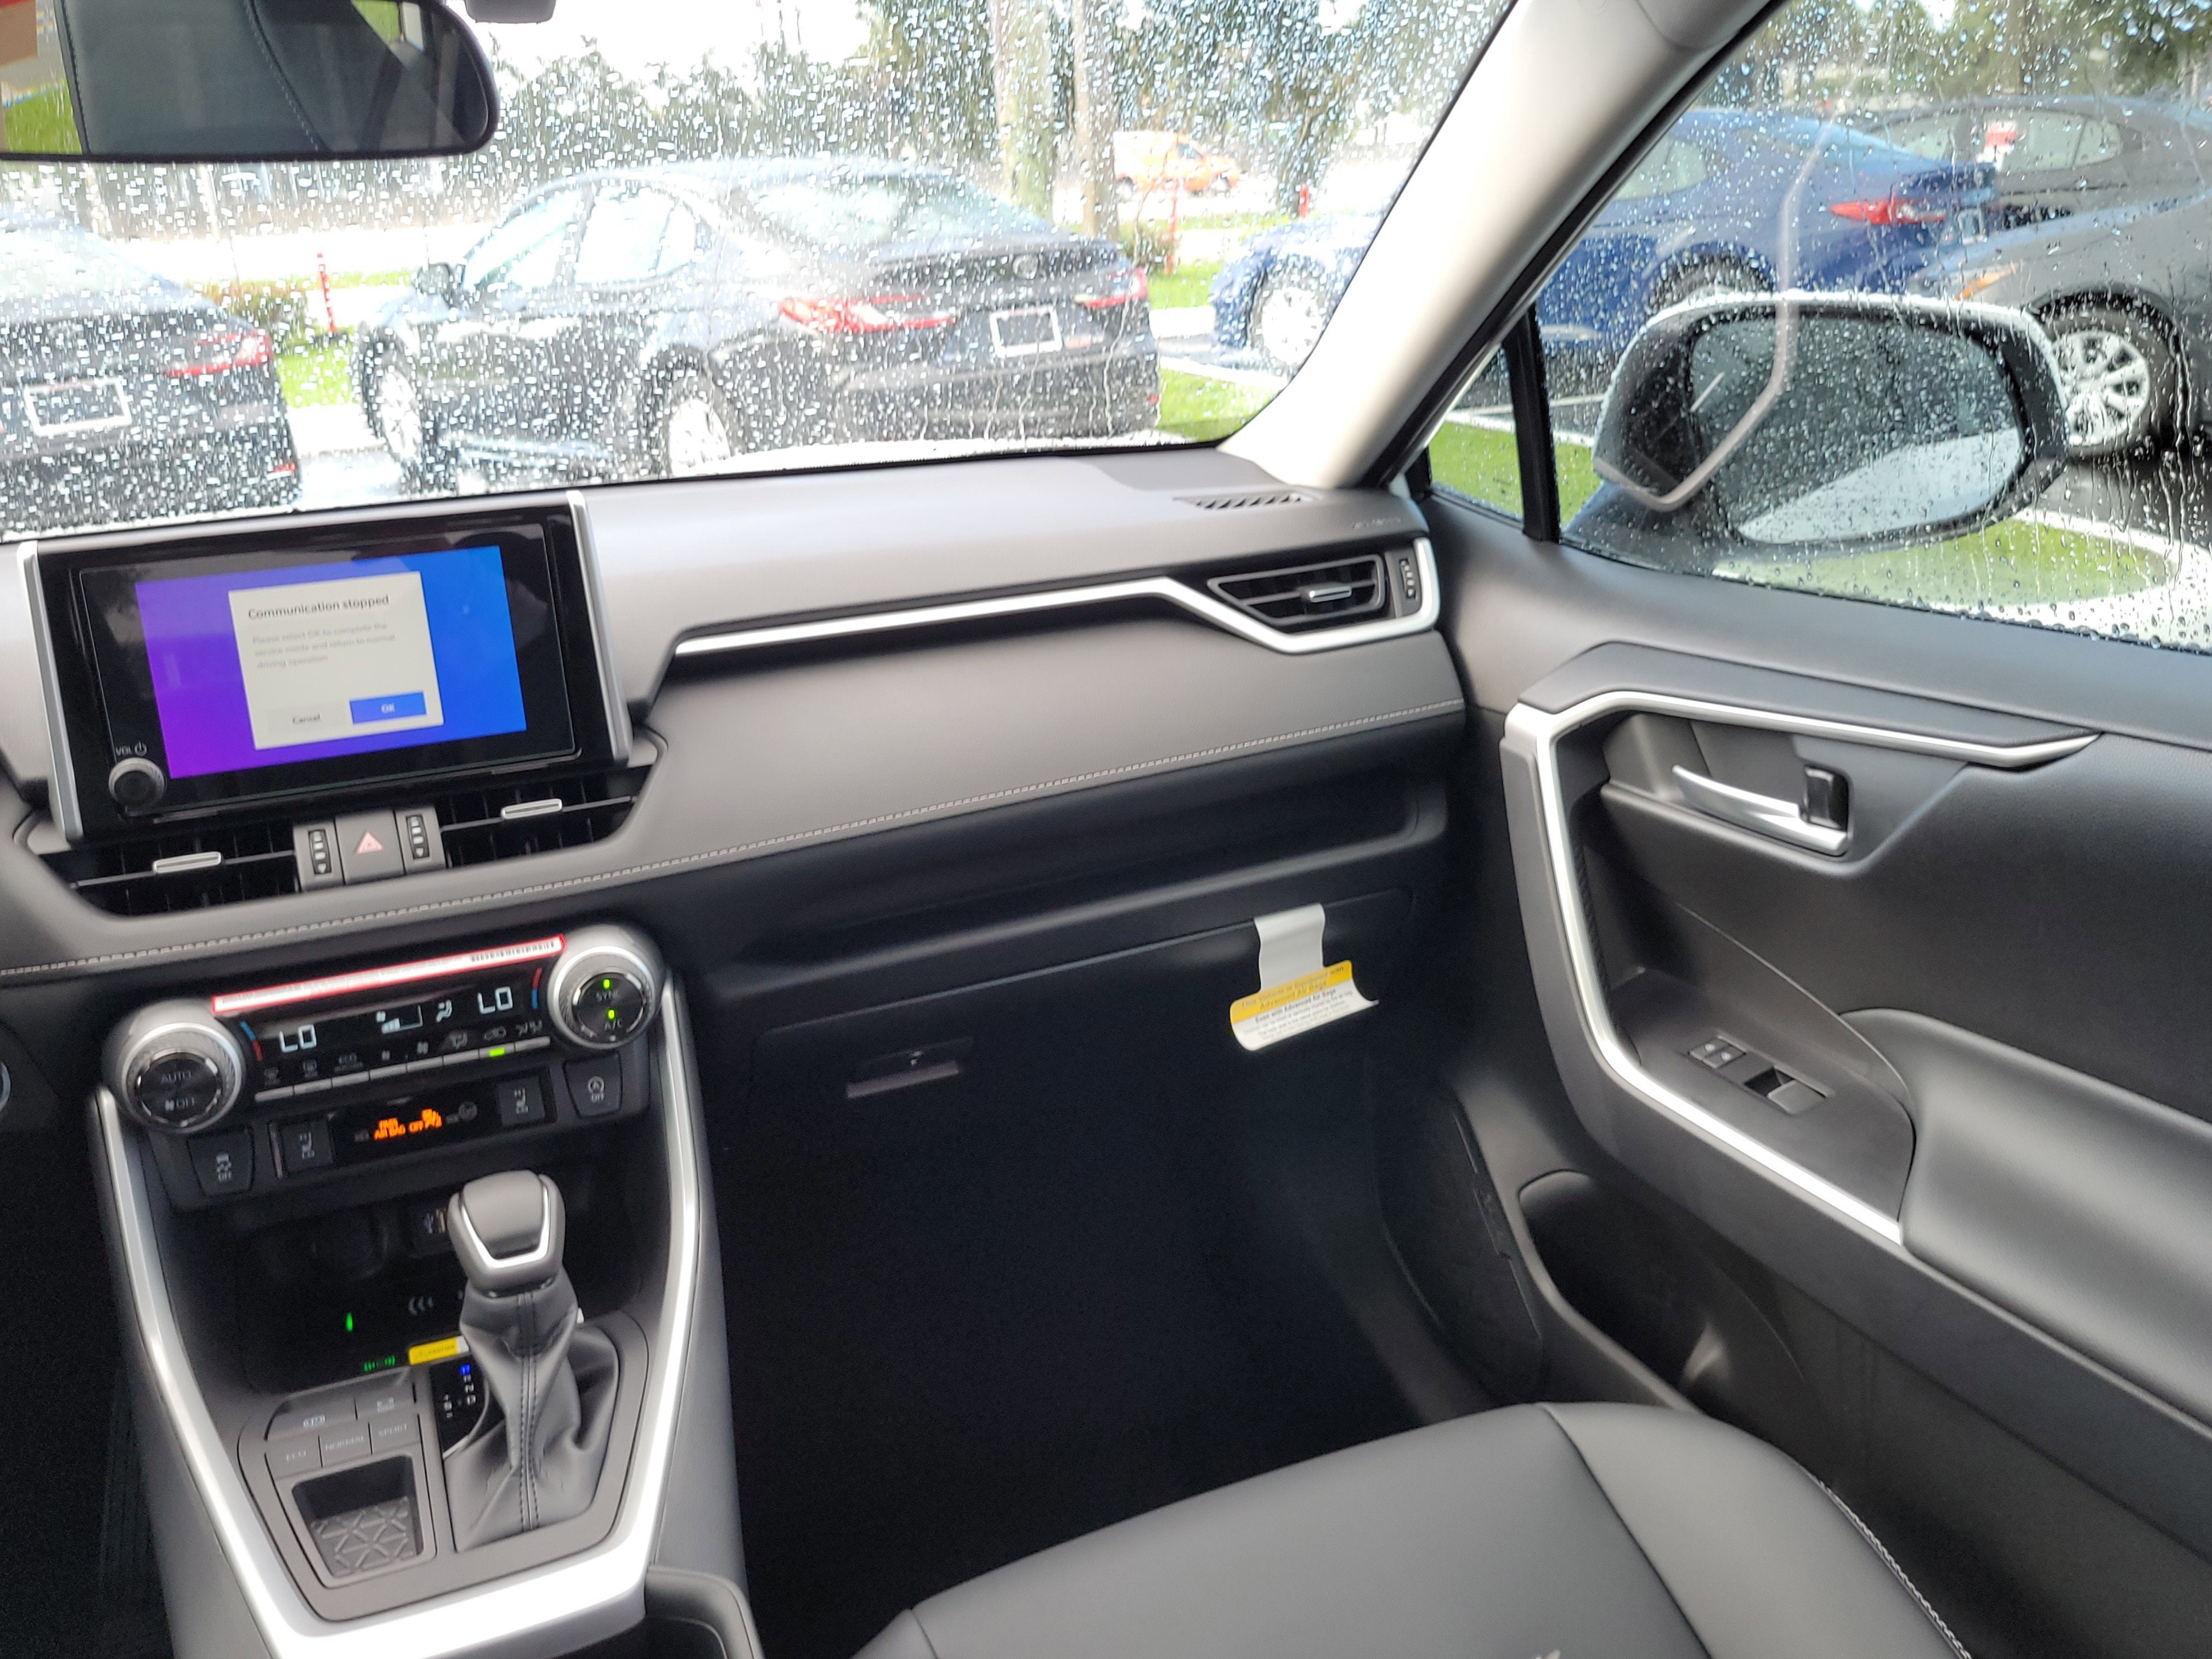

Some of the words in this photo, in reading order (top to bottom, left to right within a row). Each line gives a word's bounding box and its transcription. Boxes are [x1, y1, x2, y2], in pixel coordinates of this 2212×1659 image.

[248, 601, 340, 620] Communication
[342, 594, 390, 610] stopped
[292, 713, 321, 725] Cancel
[115, 745, 132, 756] VOL
[477, 986, 513, 1015] LO
[279, 1024, 317, 1053] LO
[161, 1070, 192, 1084] AUTO
